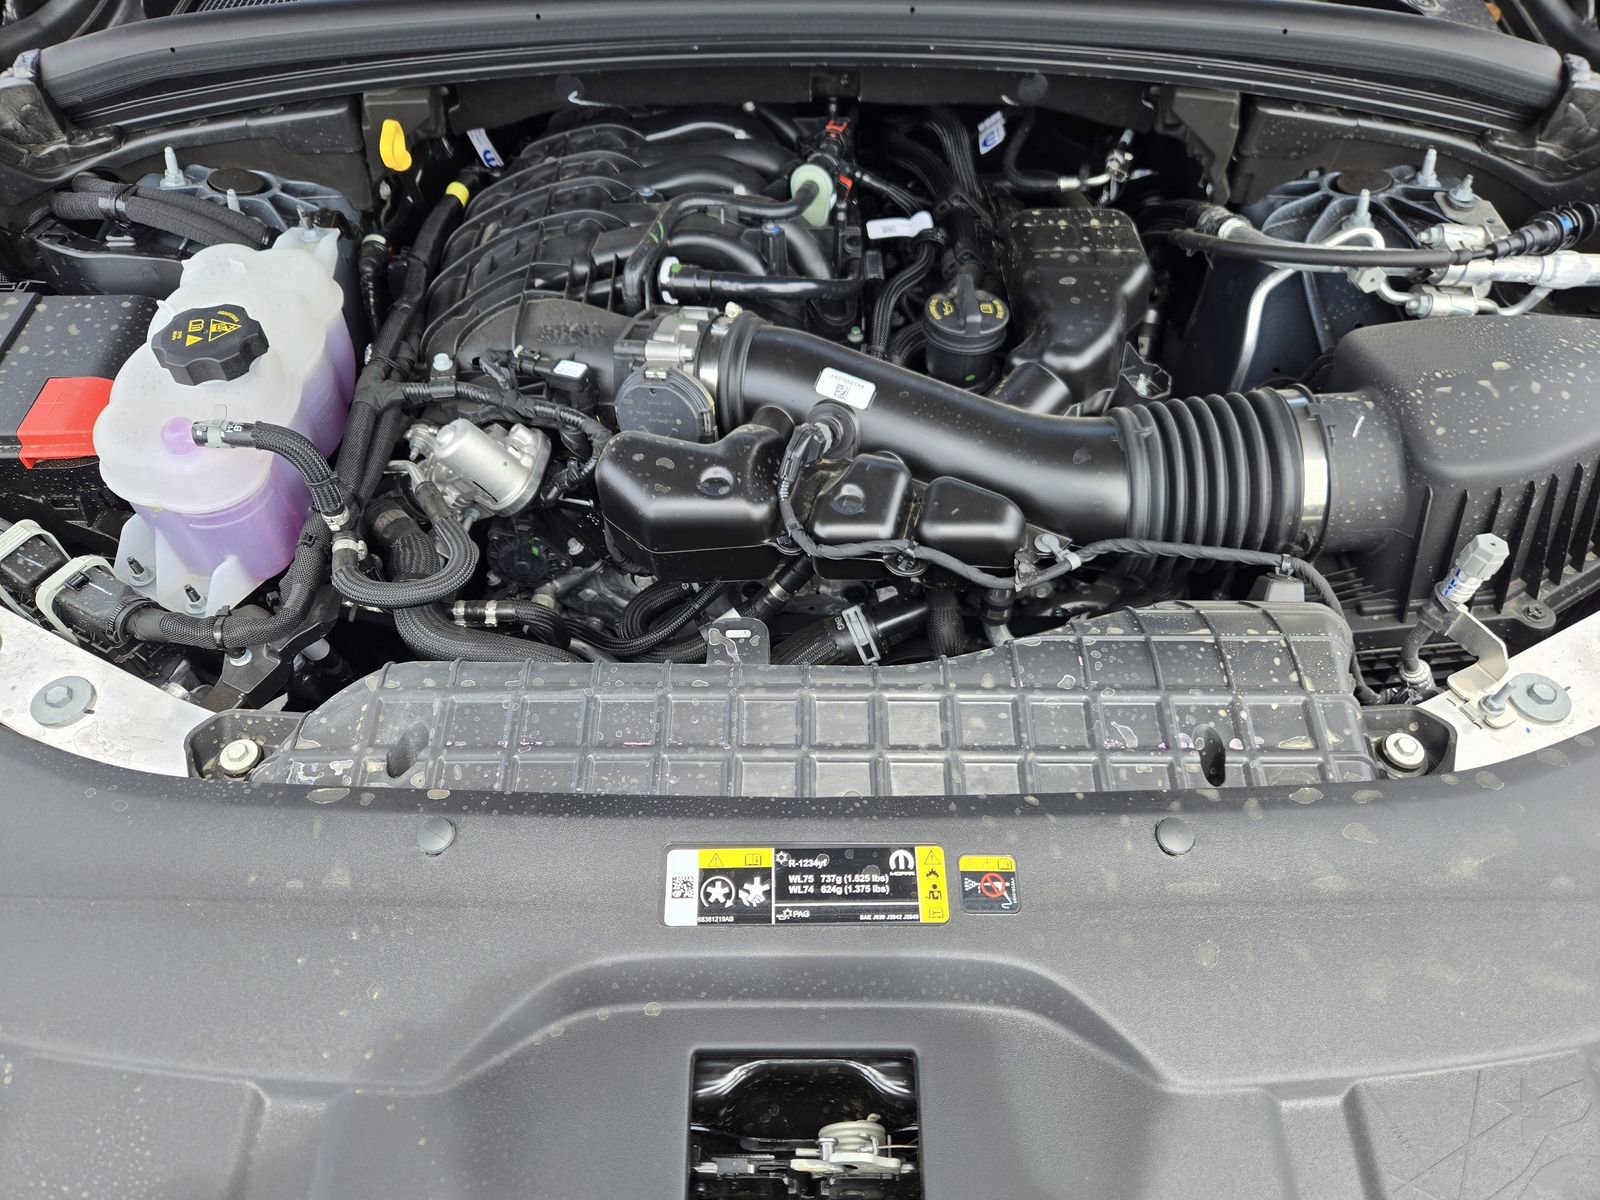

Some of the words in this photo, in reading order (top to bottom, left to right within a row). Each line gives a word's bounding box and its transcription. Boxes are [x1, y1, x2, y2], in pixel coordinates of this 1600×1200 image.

[788, 858, 827, 869] R-1234yf
[788, 874, 815, 883] WL75
[820, 873, 843, 882] 737g
[843, 873, 871, 883] (1.625
[871, 873, 889, 883] lbs)
[788, 885, 815, 894] WL74
[820, 885, 843, 895] 624g
[843, 885, 871, 894] (1.375
[872, 884, 890, 894] lbs)
[792, 910, 810, 918] PAG
